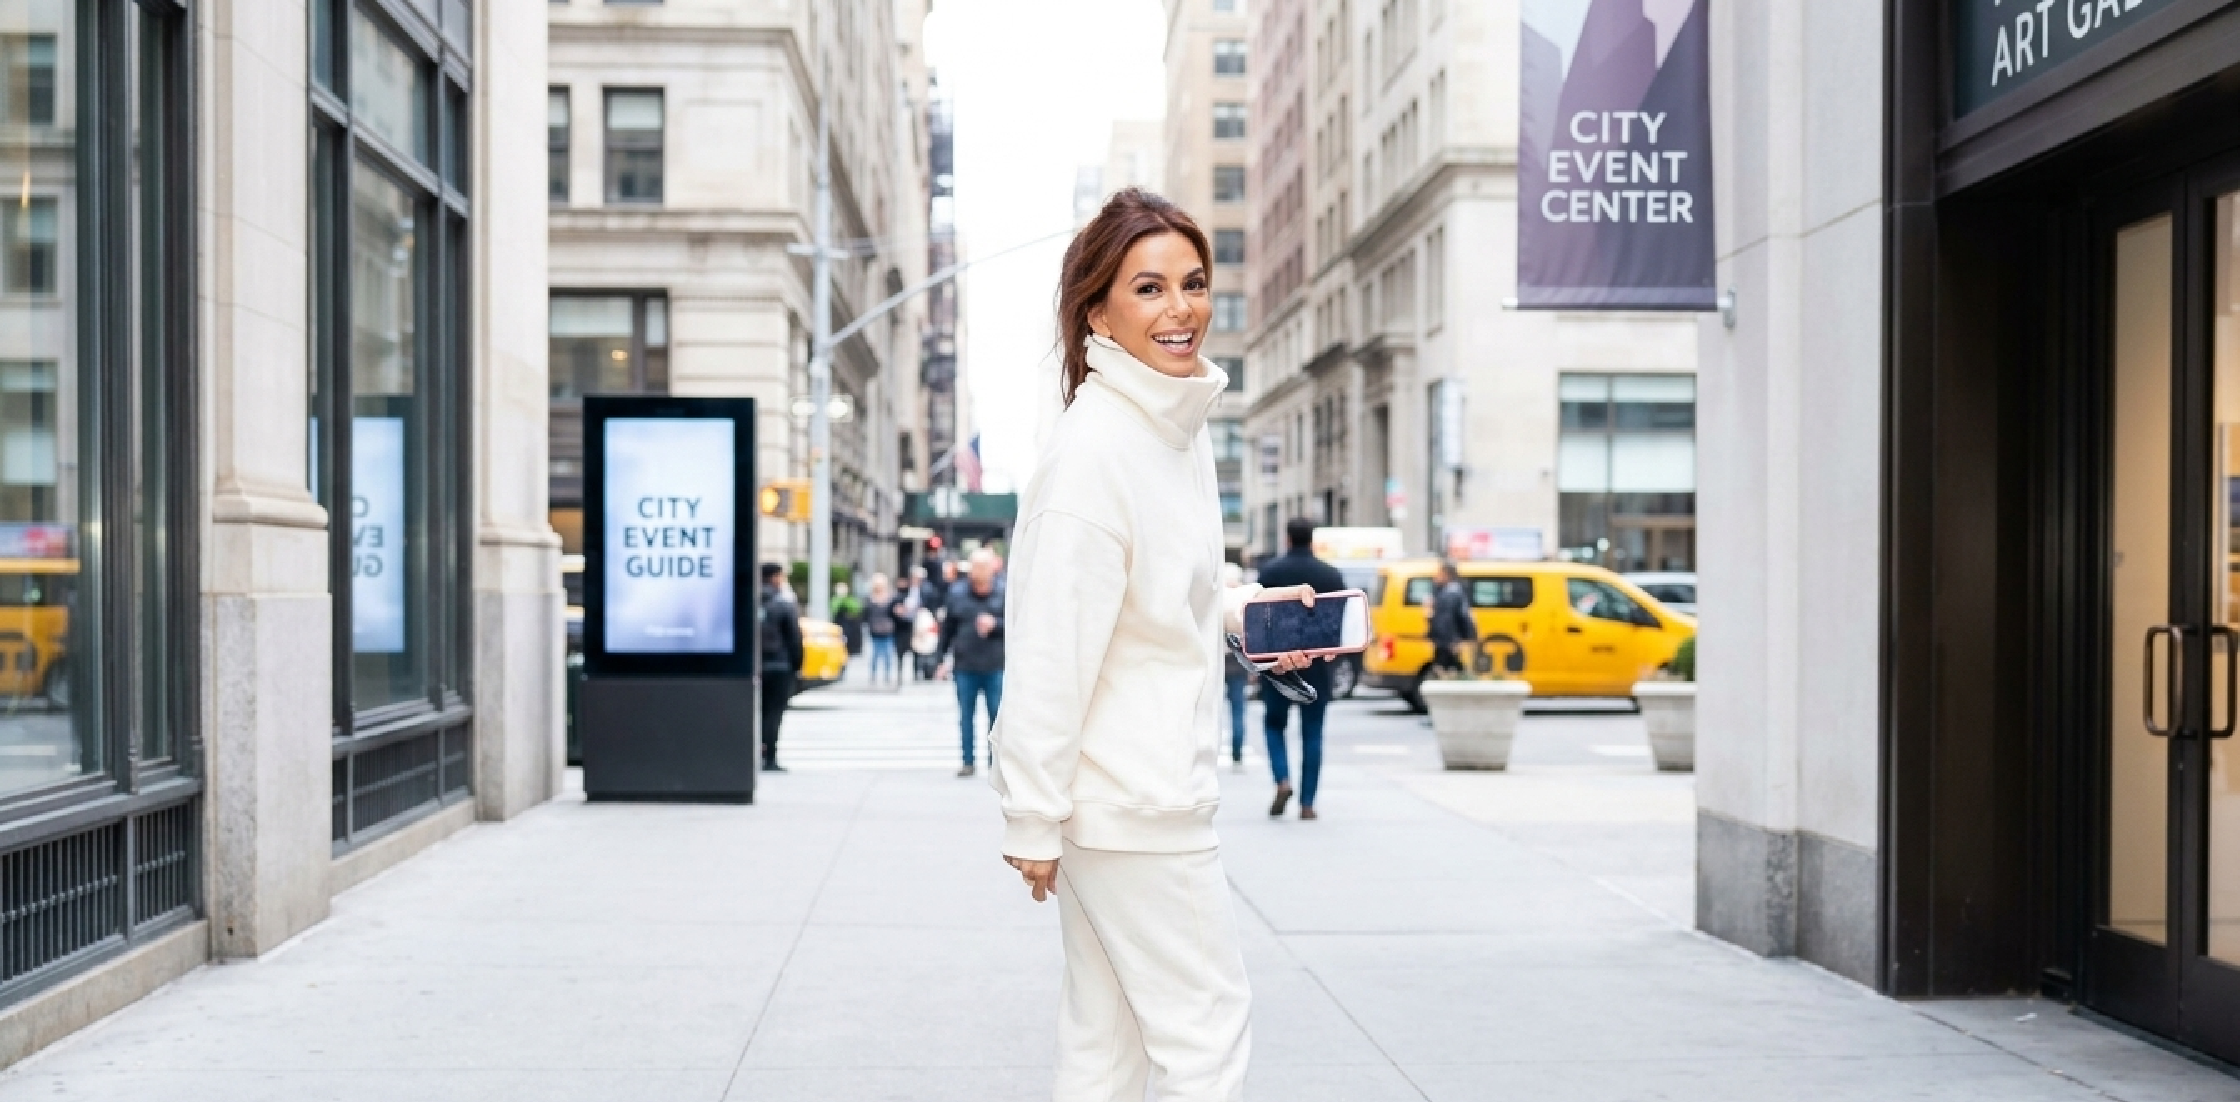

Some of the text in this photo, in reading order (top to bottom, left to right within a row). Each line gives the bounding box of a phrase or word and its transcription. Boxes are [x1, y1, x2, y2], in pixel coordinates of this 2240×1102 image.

[1991, 0, 2052, 88] ART
[1569, 110, 1667, 145] CITY
[1548, 151, 1688, 184] EVENT
[1541, 190, 1694, 223] CENTER
[637, 496, 702, 519] CITY
[623, 526, 716, 548] EVENT
[626, 555, 714, 578] GUIDE
